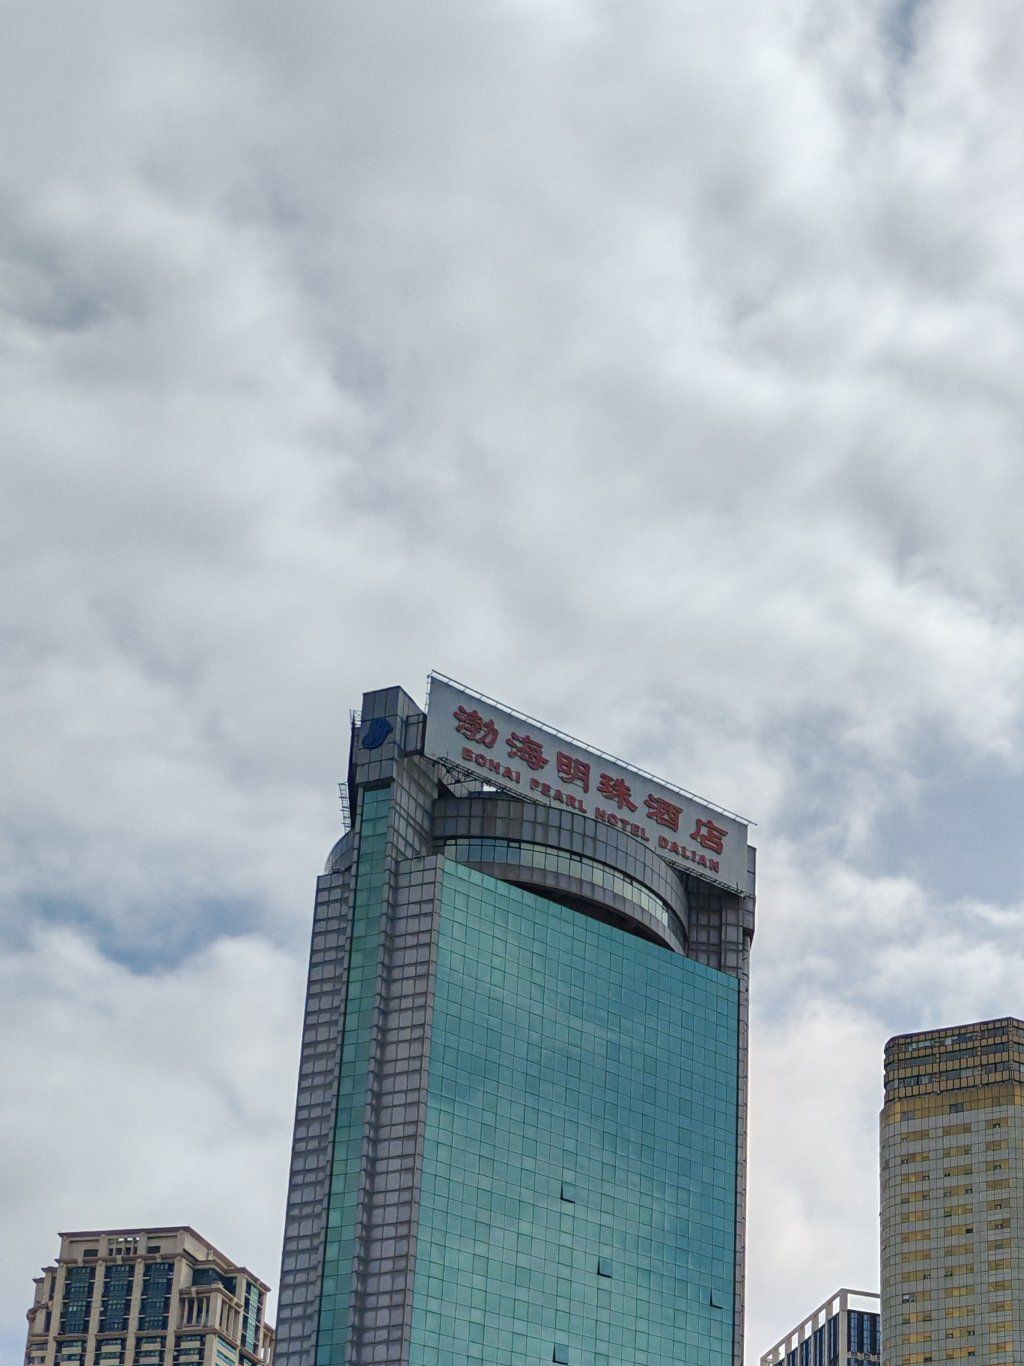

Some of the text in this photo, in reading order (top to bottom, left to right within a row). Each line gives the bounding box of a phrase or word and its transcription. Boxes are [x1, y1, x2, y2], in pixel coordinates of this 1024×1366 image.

[453, 705, 728, 855] 渤海明珠酒店
[462, 747, 720, 874] BOHAI PEARL HOTEL DALIAN
